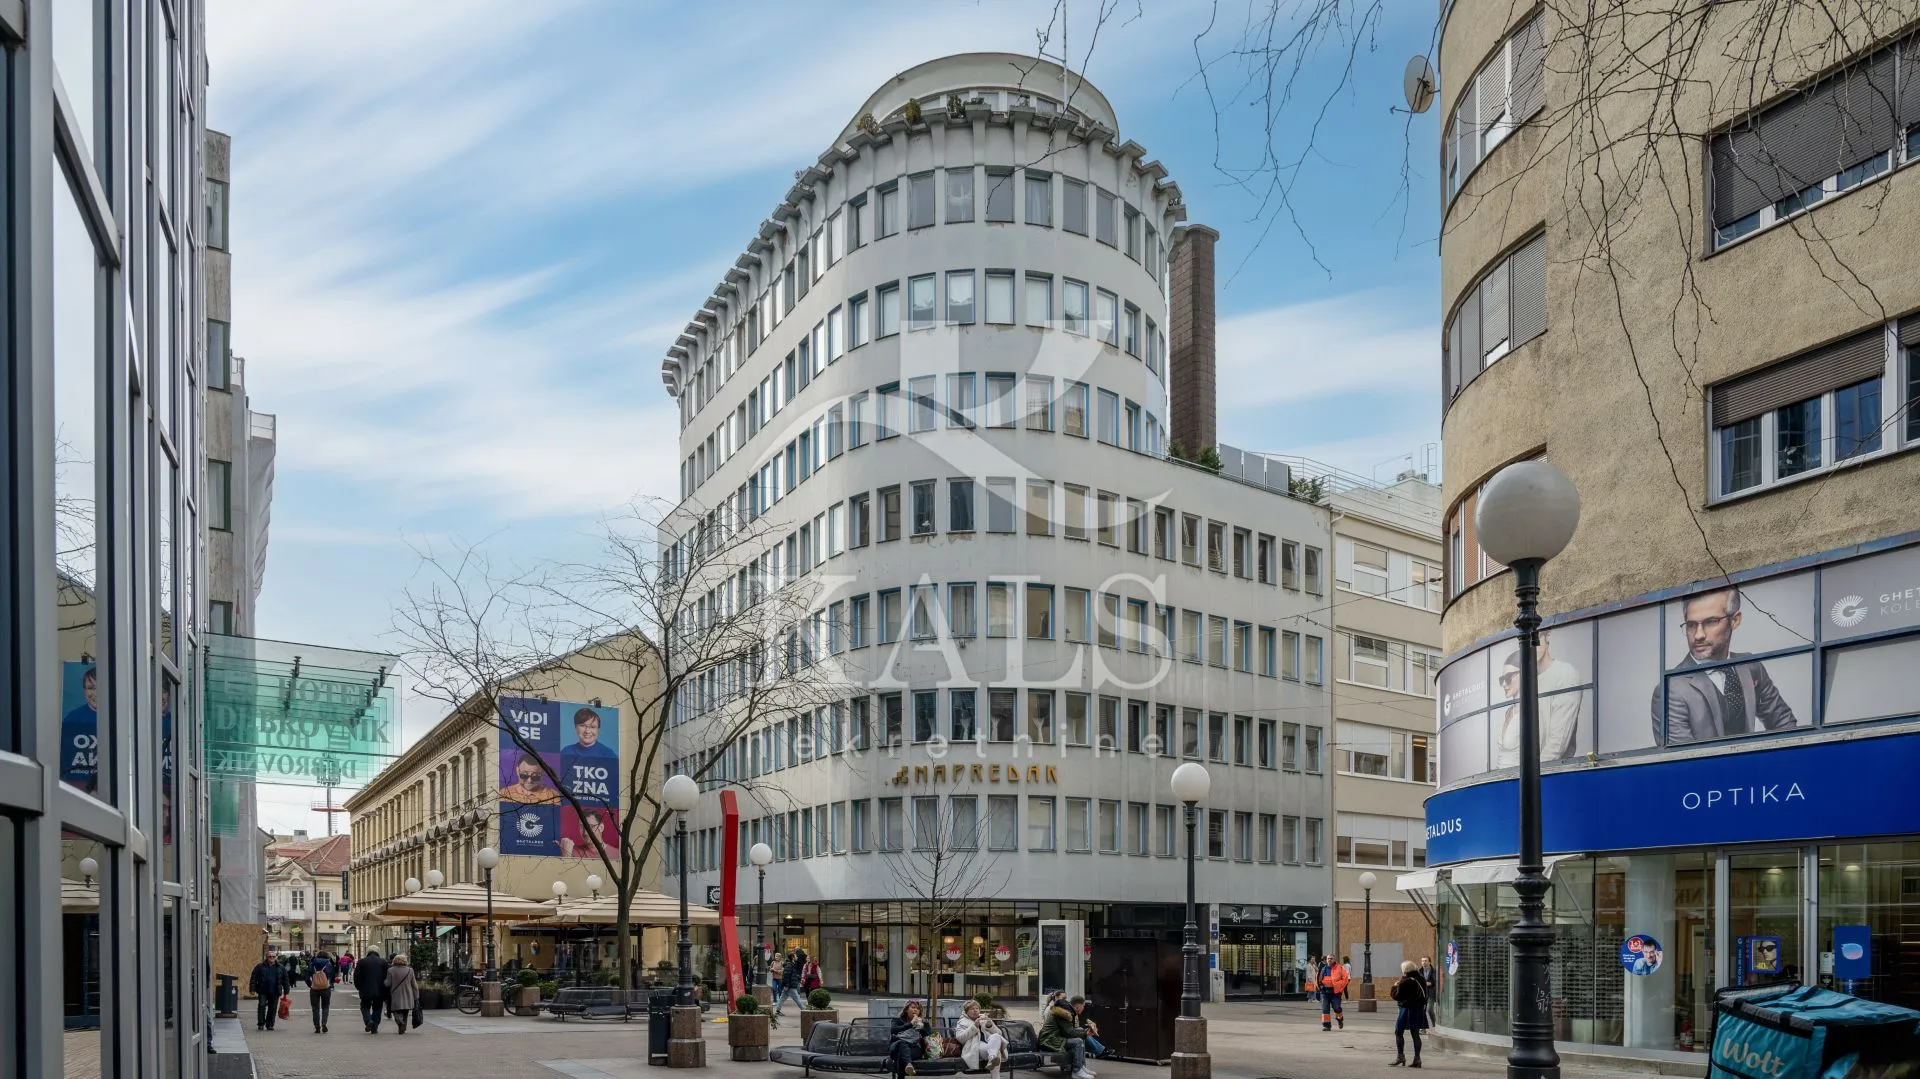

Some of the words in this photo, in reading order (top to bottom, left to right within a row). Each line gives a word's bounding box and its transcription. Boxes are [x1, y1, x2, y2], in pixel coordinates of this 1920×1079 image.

[509, 709, 548, 726] VIDI
[518, 725, 542, 741] SE
[573, 765, 609, 781] TKO
[914, 763, 1059, 784] NAPREDAK
[572, 780, 609, 796] ZNA
[1682, 782, 1806, 810] OPTIKA
[1722, 1037, 1785, 1078] Wolt
